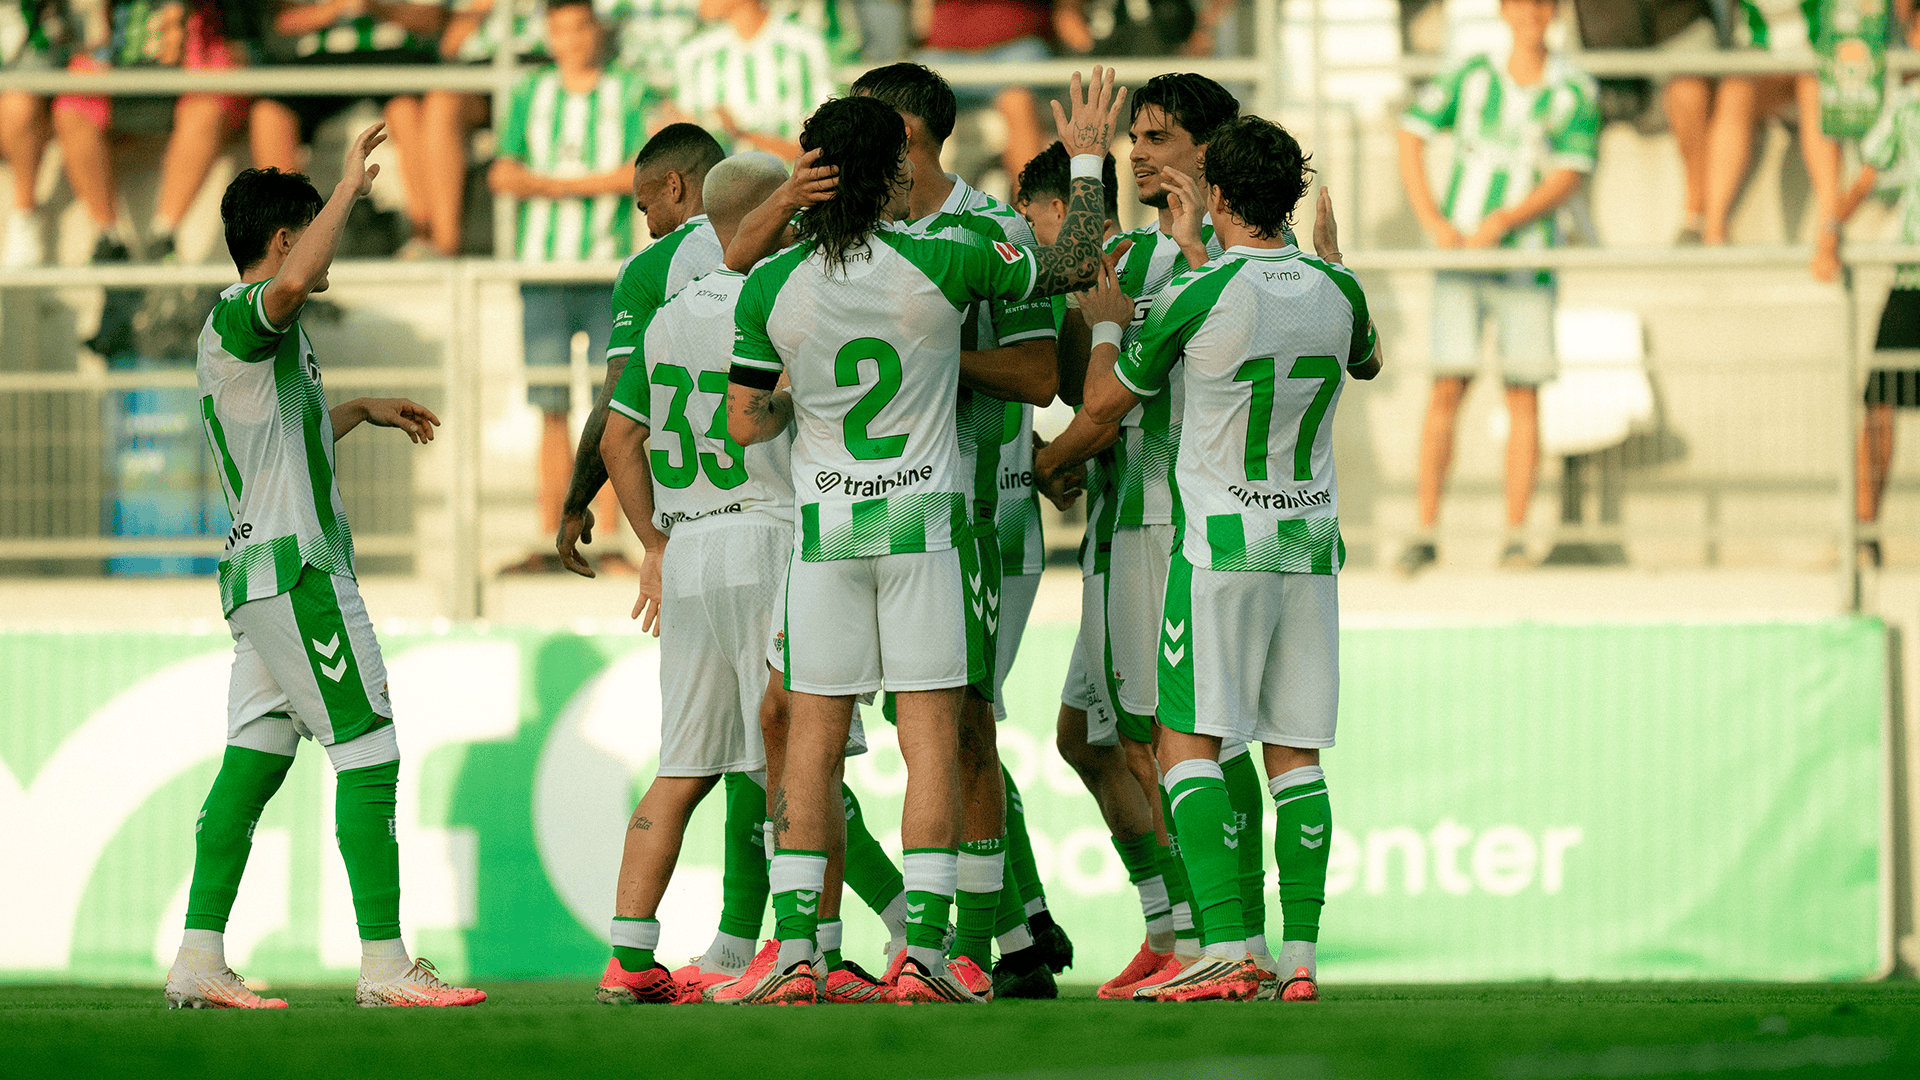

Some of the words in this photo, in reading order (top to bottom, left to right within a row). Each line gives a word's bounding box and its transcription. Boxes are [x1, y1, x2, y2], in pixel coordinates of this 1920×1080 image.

[834, 250, 870, 264] rima
[1262, 271, 1301, 282] prima
[695, 289, 727, 303] prima
[649, 361, 749, 490] 33
[834, 336, 910, 461] 2
[1232, 355, 1342, 482] 17
[843, 464, 933, 497] trainline
[1319, 820, 1586, 897] enter
